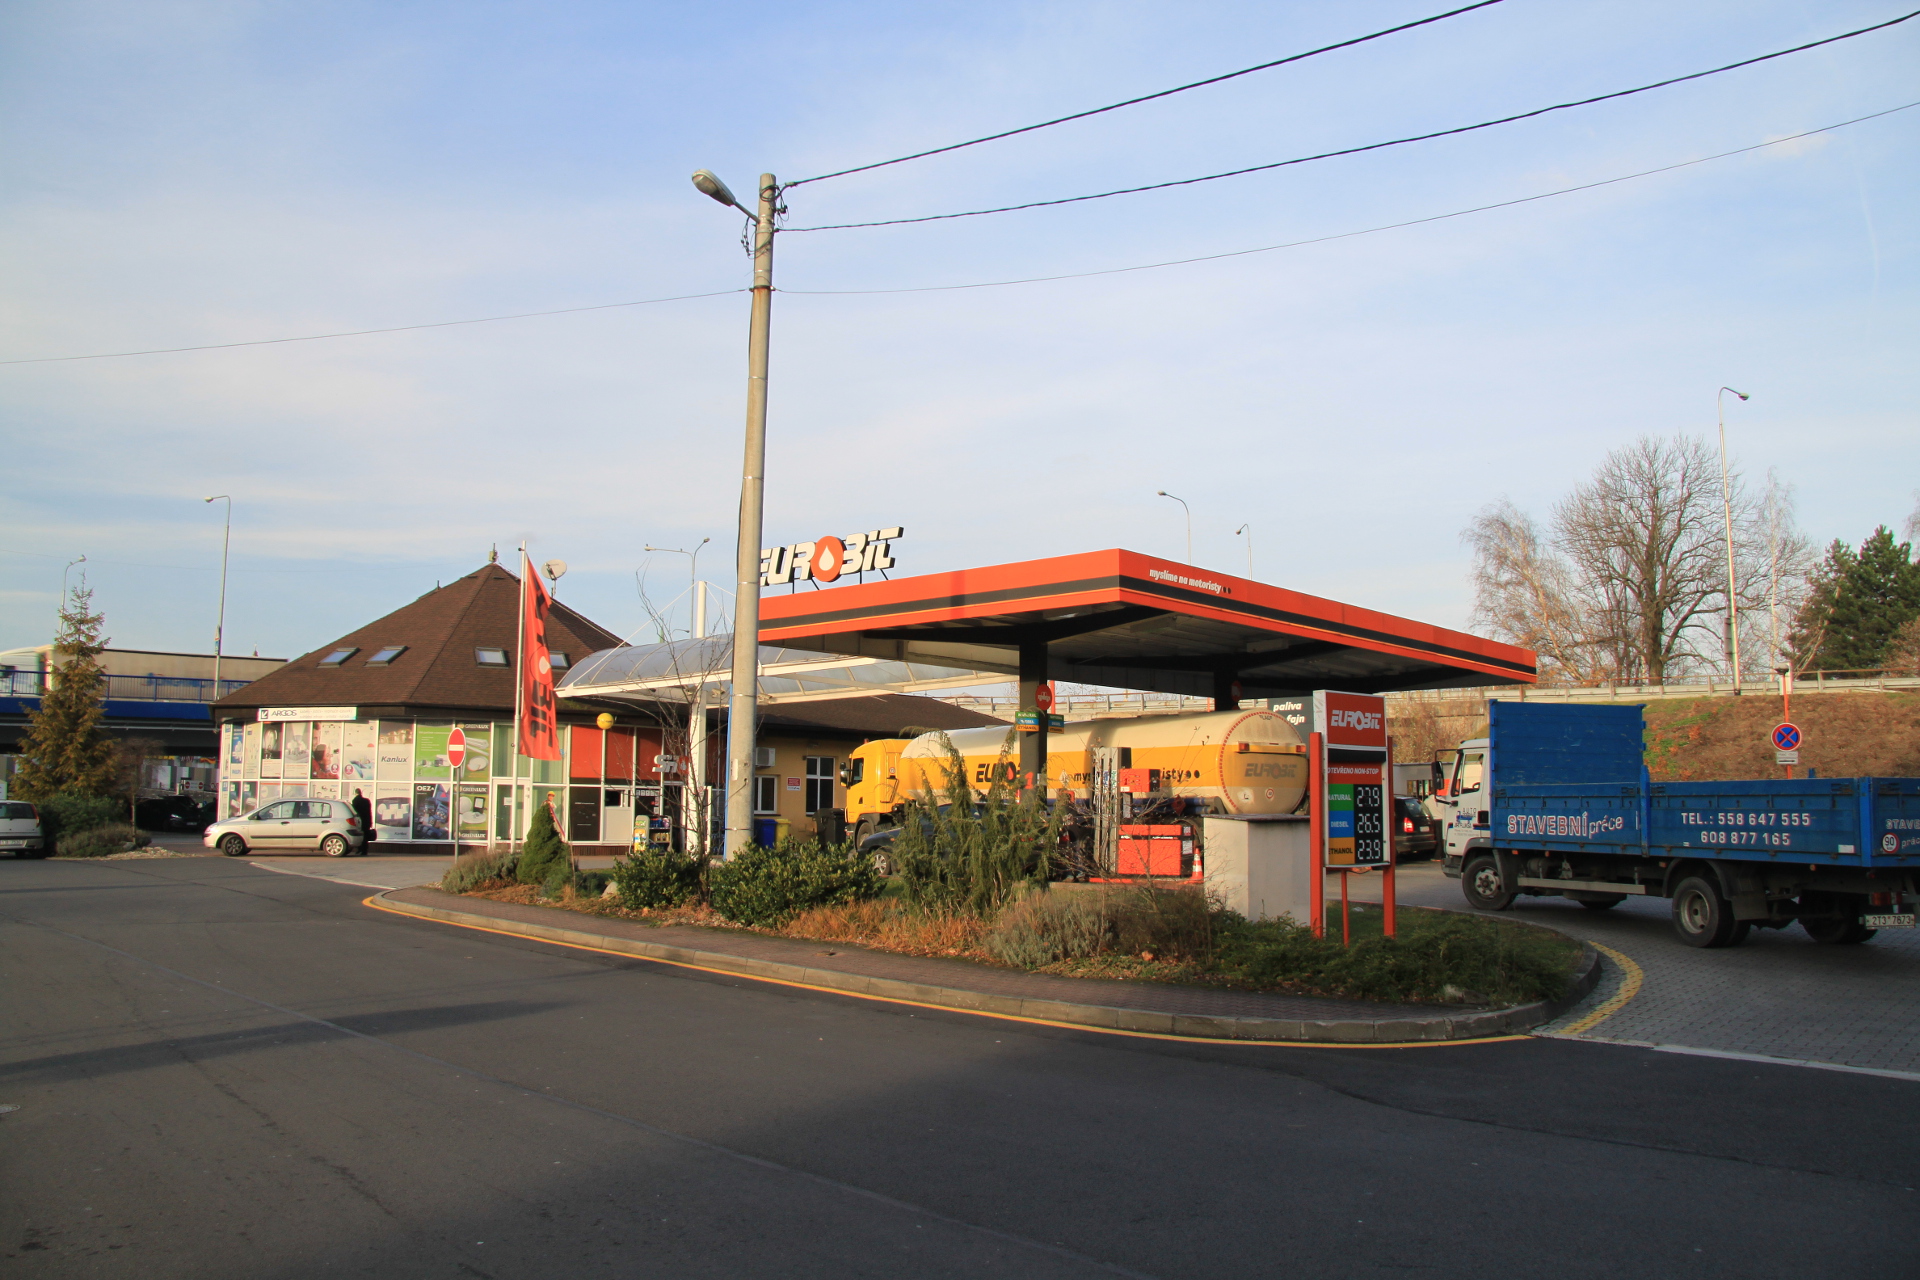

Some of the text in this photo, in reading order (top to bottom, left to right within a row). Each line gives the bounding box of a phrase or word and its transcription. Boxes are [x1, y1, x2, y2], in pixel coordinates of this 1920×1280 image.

[1178, 576, 1188, 585] na
[1189, 578, 1221, 594] motoristy
[1272, 702, 1302, 713] paliva
[380, 755, 409, 763] Kanlux
[1507, 811, 1588, 837] STAVEBNÍ
[1588, 814, 1624, 840] práce
[1681, 812, 1812, 826] TEL.: 558 647 555
[1700, 831, 1792, 846] 608 877 165
[1884, 836, 1895, 846] 90
